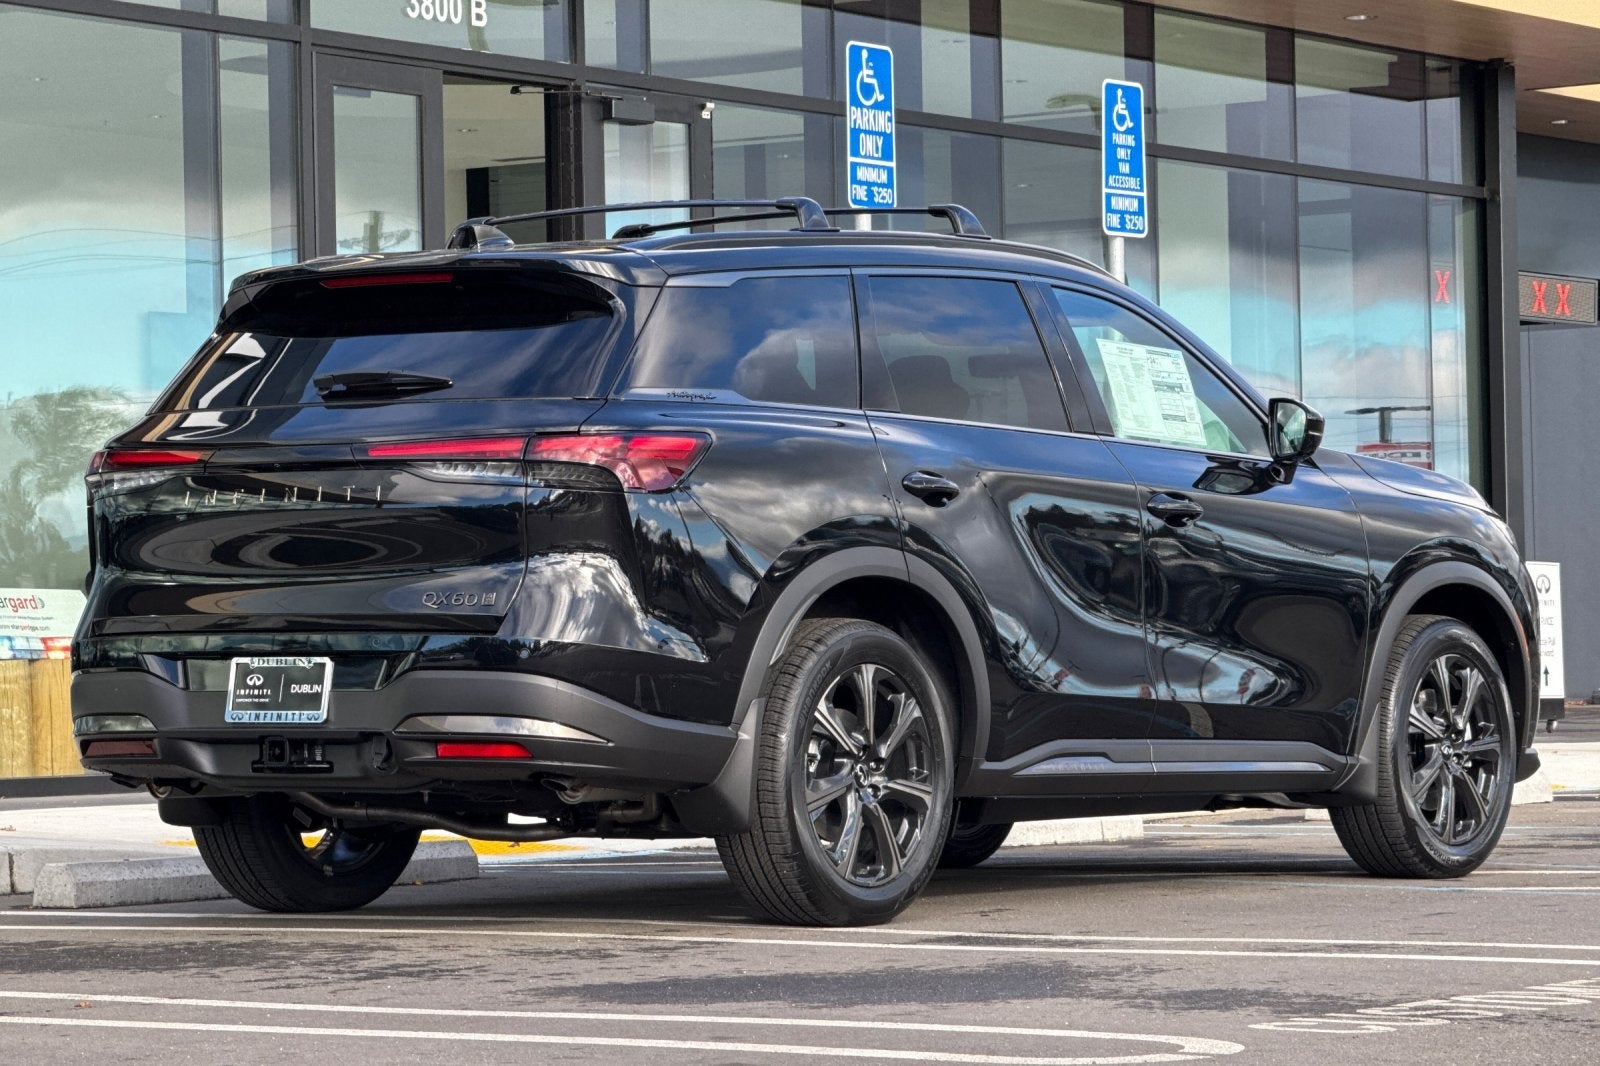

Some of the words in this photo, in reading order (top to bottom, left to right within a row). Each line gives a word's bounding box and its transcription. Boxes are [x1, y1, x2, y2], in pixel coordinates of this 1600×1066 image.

[470, 0, 488, 27] B
[851, 106, 892, 134] PARKING
[859, 133, 883, 158] ONLY
[1112, 132, 1135, 147] PARKING
[1116, 147, 1131, 161] ONLY
[856, 166, 888, 184] MINIMUM
[1118, 162, 1130, 174] VAN
[1108, 175, 1140, 190] ACCESSIBLE
[852, 184, 868, 201] FINE
[872, 187, 892, 204] $250
[1111, 196, 1138, 212] MINIMUM
[1107, 212, 1121, 228] FINE
[1125, 214, 1143, 231] $250
[185, 485, 380, 506] INFINITI
[422, 591, 478, 608] QX60
[257, 658, 306, 666] DUBLIN
[236, 688, 271, 696] INFINITI
[291, 684, 322, 693] DUBLIN
[248, 712, 302, 721] INFINITI
[1247, 977, 1600, 1034] CUSTOM
